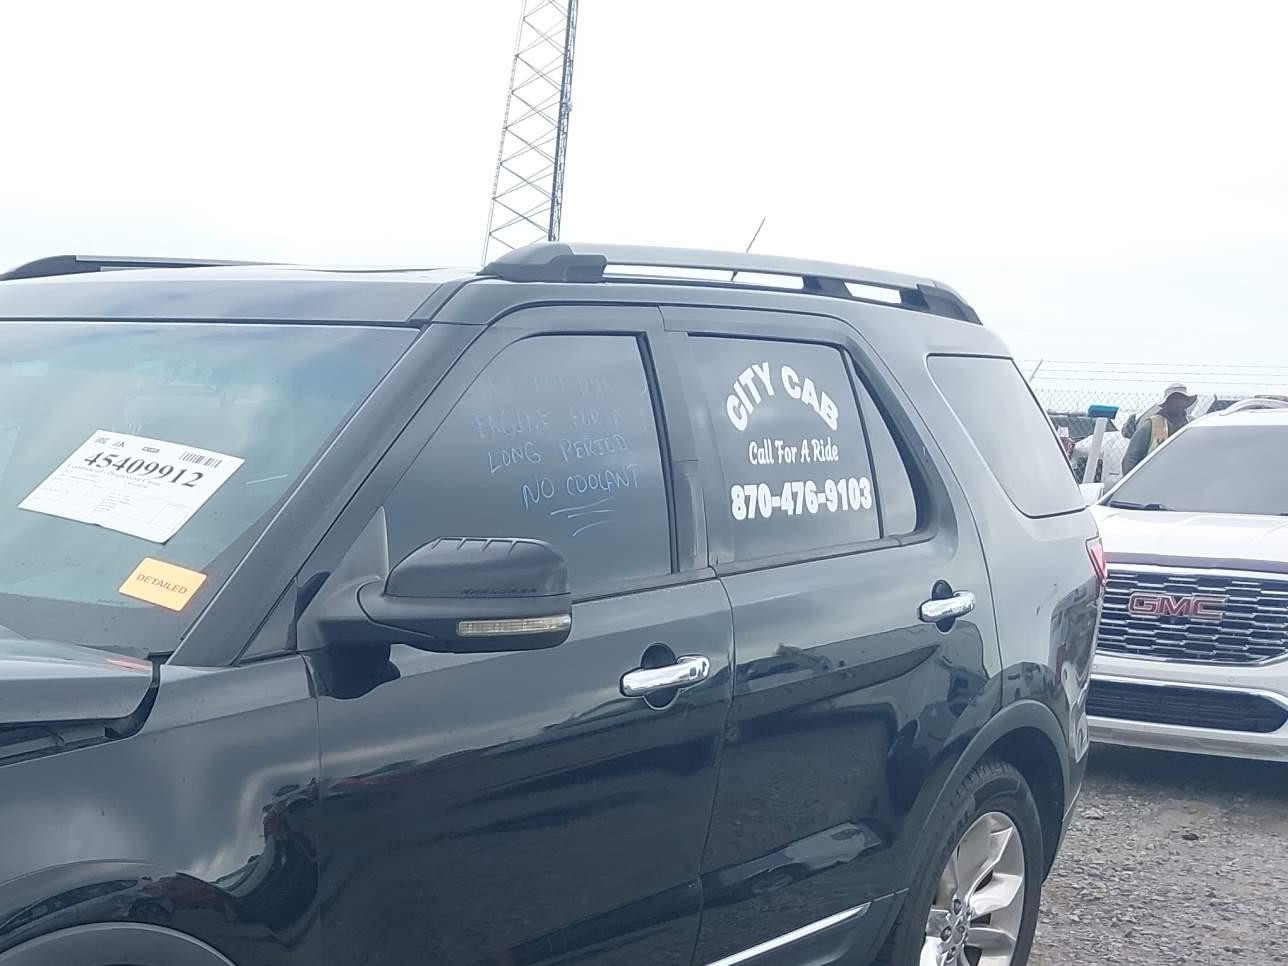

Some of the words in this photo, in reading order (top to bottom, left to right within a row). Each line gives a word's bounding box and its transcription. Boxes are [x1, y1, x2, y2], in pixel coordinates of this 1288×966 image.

[726, 362, 775, 431] CITY
[781, 365, 839, 431] CAB
[83, 451, 205, 489] 45409912
[488, 441, 542, 474] LONG
[558, 433, 629, 462] PERIOD
[749, 438, 774, 465] Call
[775, 440, 797, 464] For
[801, 439, 811, 463] A
[813, 437, 839, 463] Ride
[522, 475, 555, 509] NO
[566, 463, 640, 496] COOLANT
[731, 477, 872, 520] 870-476-9103
[136, 573, 188, 595] DETAILED
[1129, 592, 1226, 623] GMC
